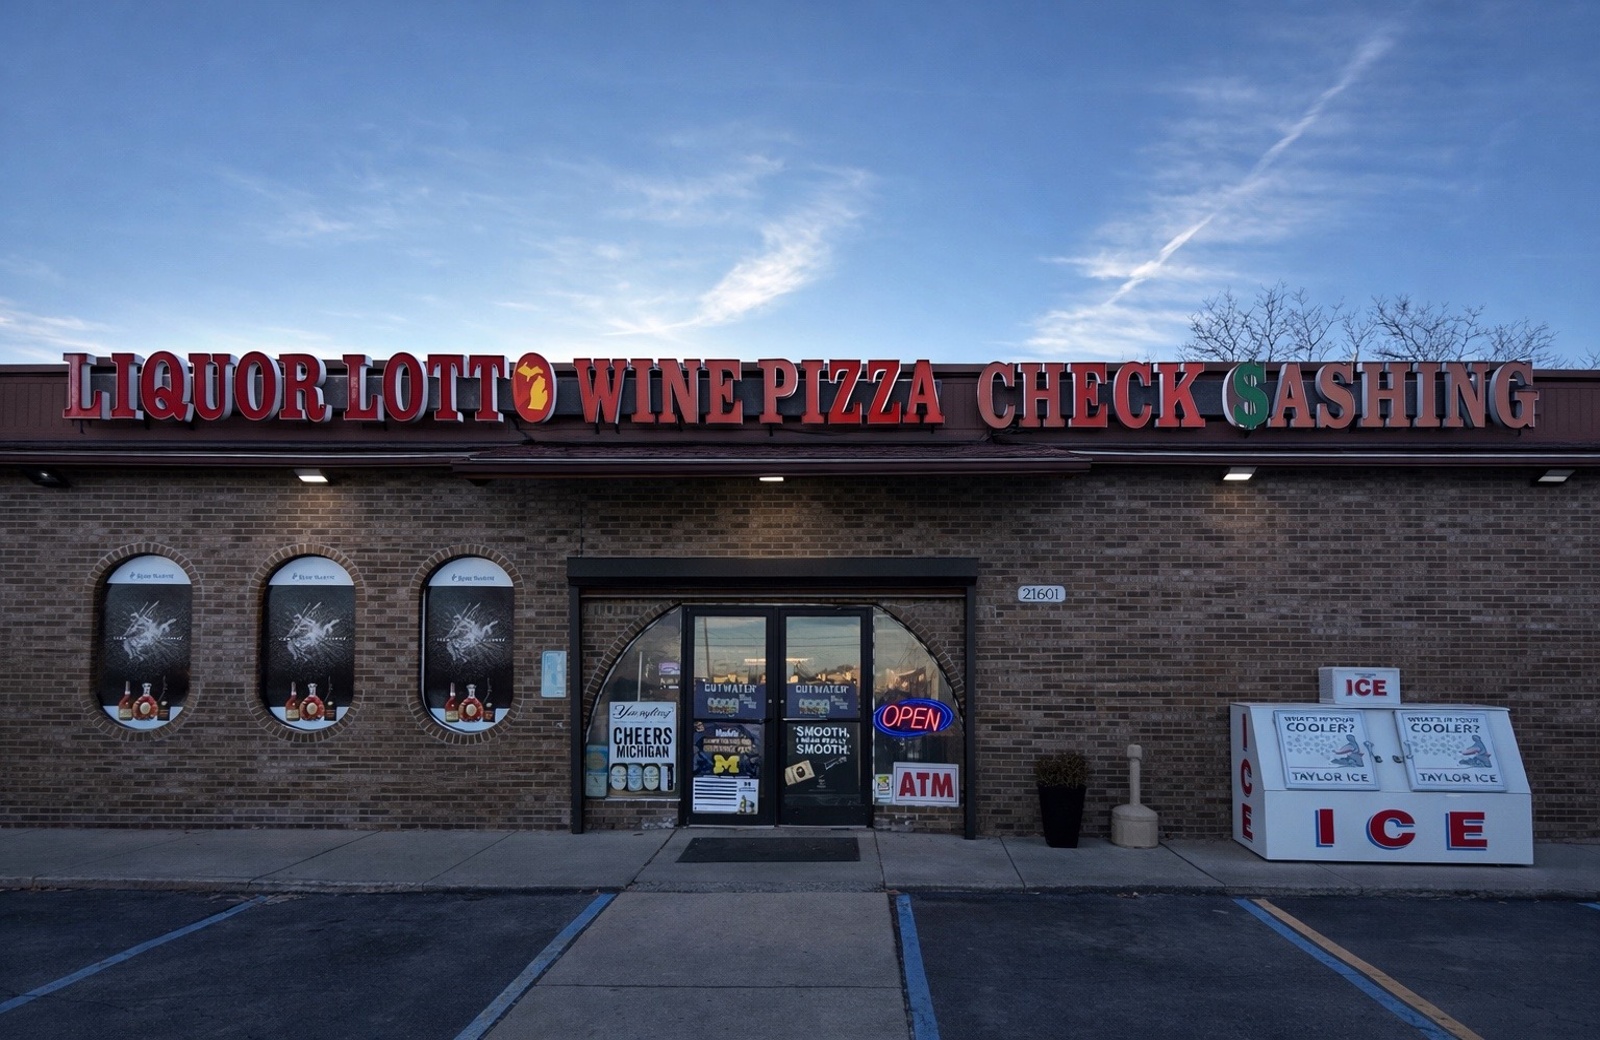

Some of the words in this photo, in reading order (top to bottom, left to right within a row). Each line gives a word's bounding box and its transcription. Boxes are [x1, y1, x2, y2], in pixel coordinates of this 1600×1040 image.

[63, 351, 332, 423] LIQUOR
[573, 358, 744, 425] WINE
[757, 358, 946, 426] PIZZA
[976, 360, 1206, 430] CHECK
[1022, 587, 1060, 600] 21601
[1345, 678, 1388, 697] ICE
[882, 704, 941, 732] OPEN
[1286, 722, 1355, 733] COOLER?
[613, 726, 673, 745] CHEERS
[1410, 723, 1480, 734] COOLER?
[616, 745, 670, 758] MICHIGAN
[713, 754, 740, 774] M
[898, 771, 954, 798] ATM
[1291, 771, 1343, 782] TAYLOR
[1346, 772, 1370, 783] ICE
[1419, 772, 1472, 783] TAYLOR
[1474, 773, 1499, 783] ICE
[1315, 807, 1489, 852] ICE
